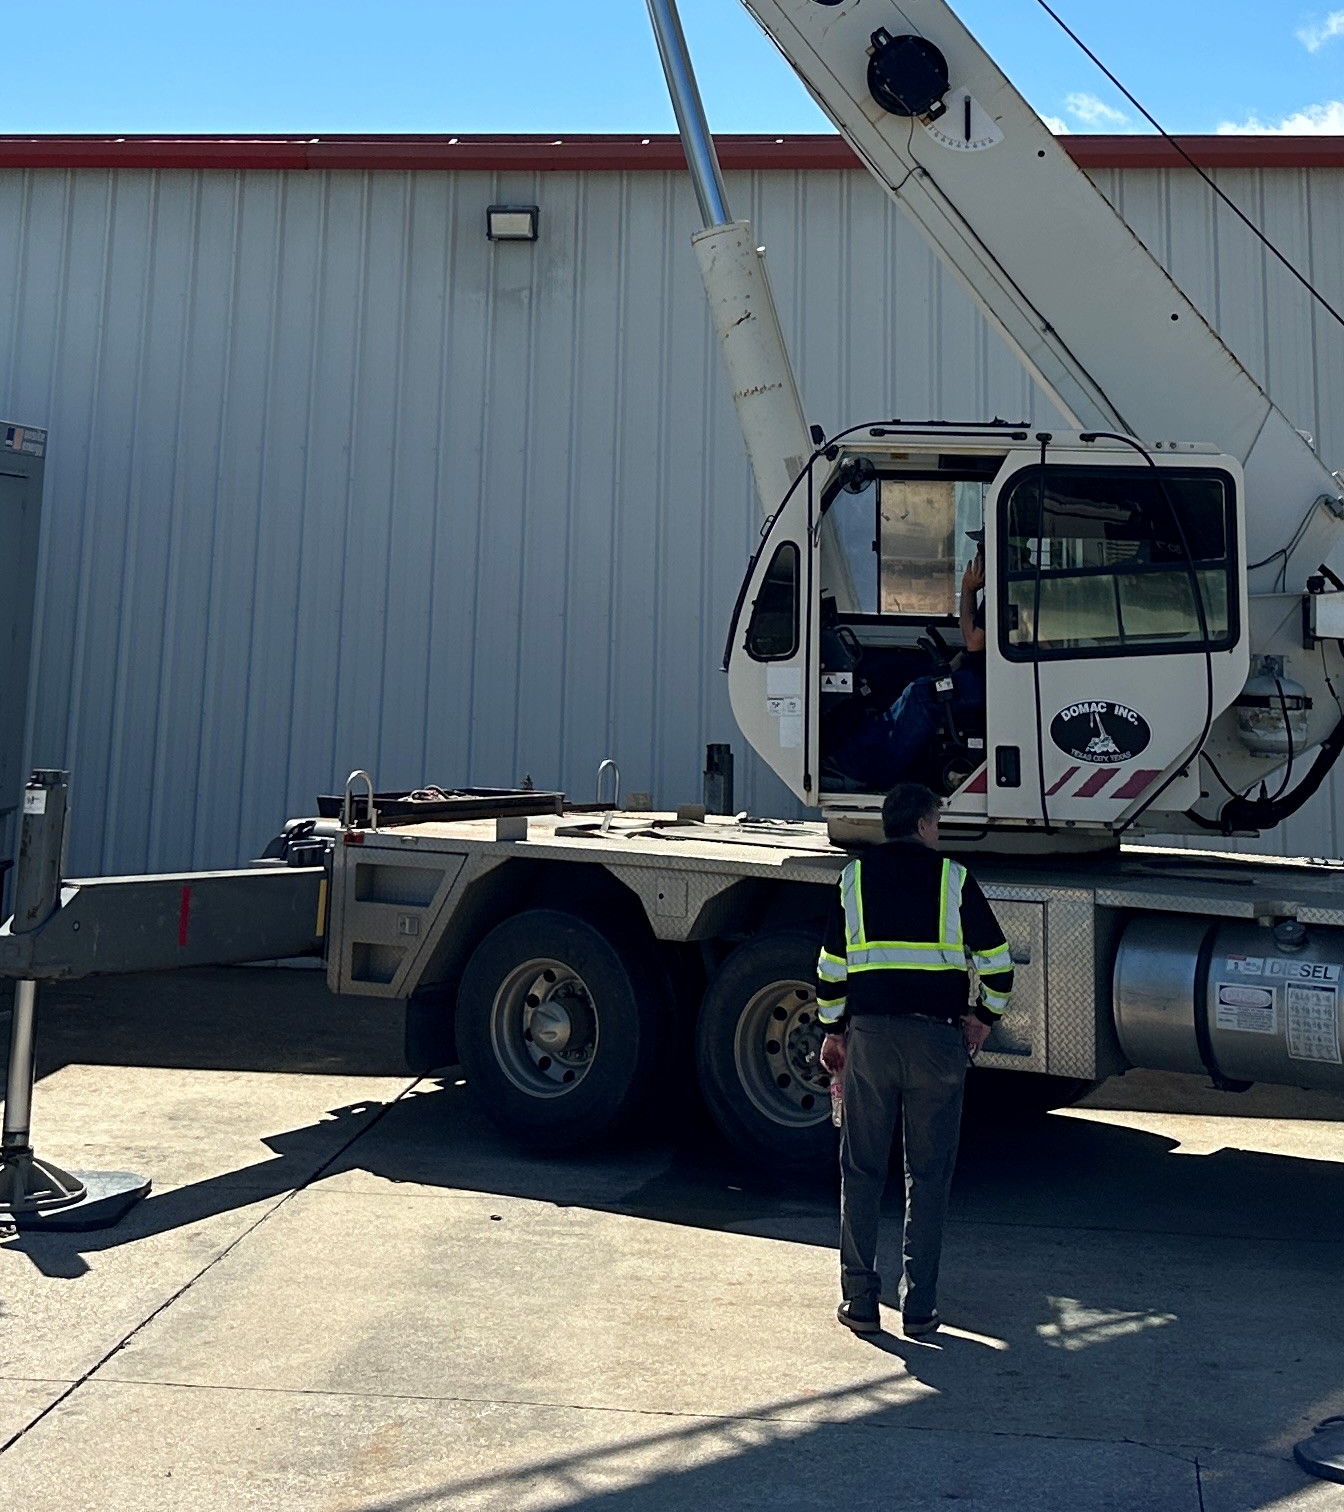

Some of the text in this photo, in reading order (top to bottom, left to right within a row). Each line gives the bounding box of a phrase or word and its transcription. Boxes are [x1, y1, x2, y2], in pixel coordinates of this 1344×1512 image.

[1060, 702, 1138, 726] DOMAC INC.
[1269, 961, 1334, 980] DIESEL
